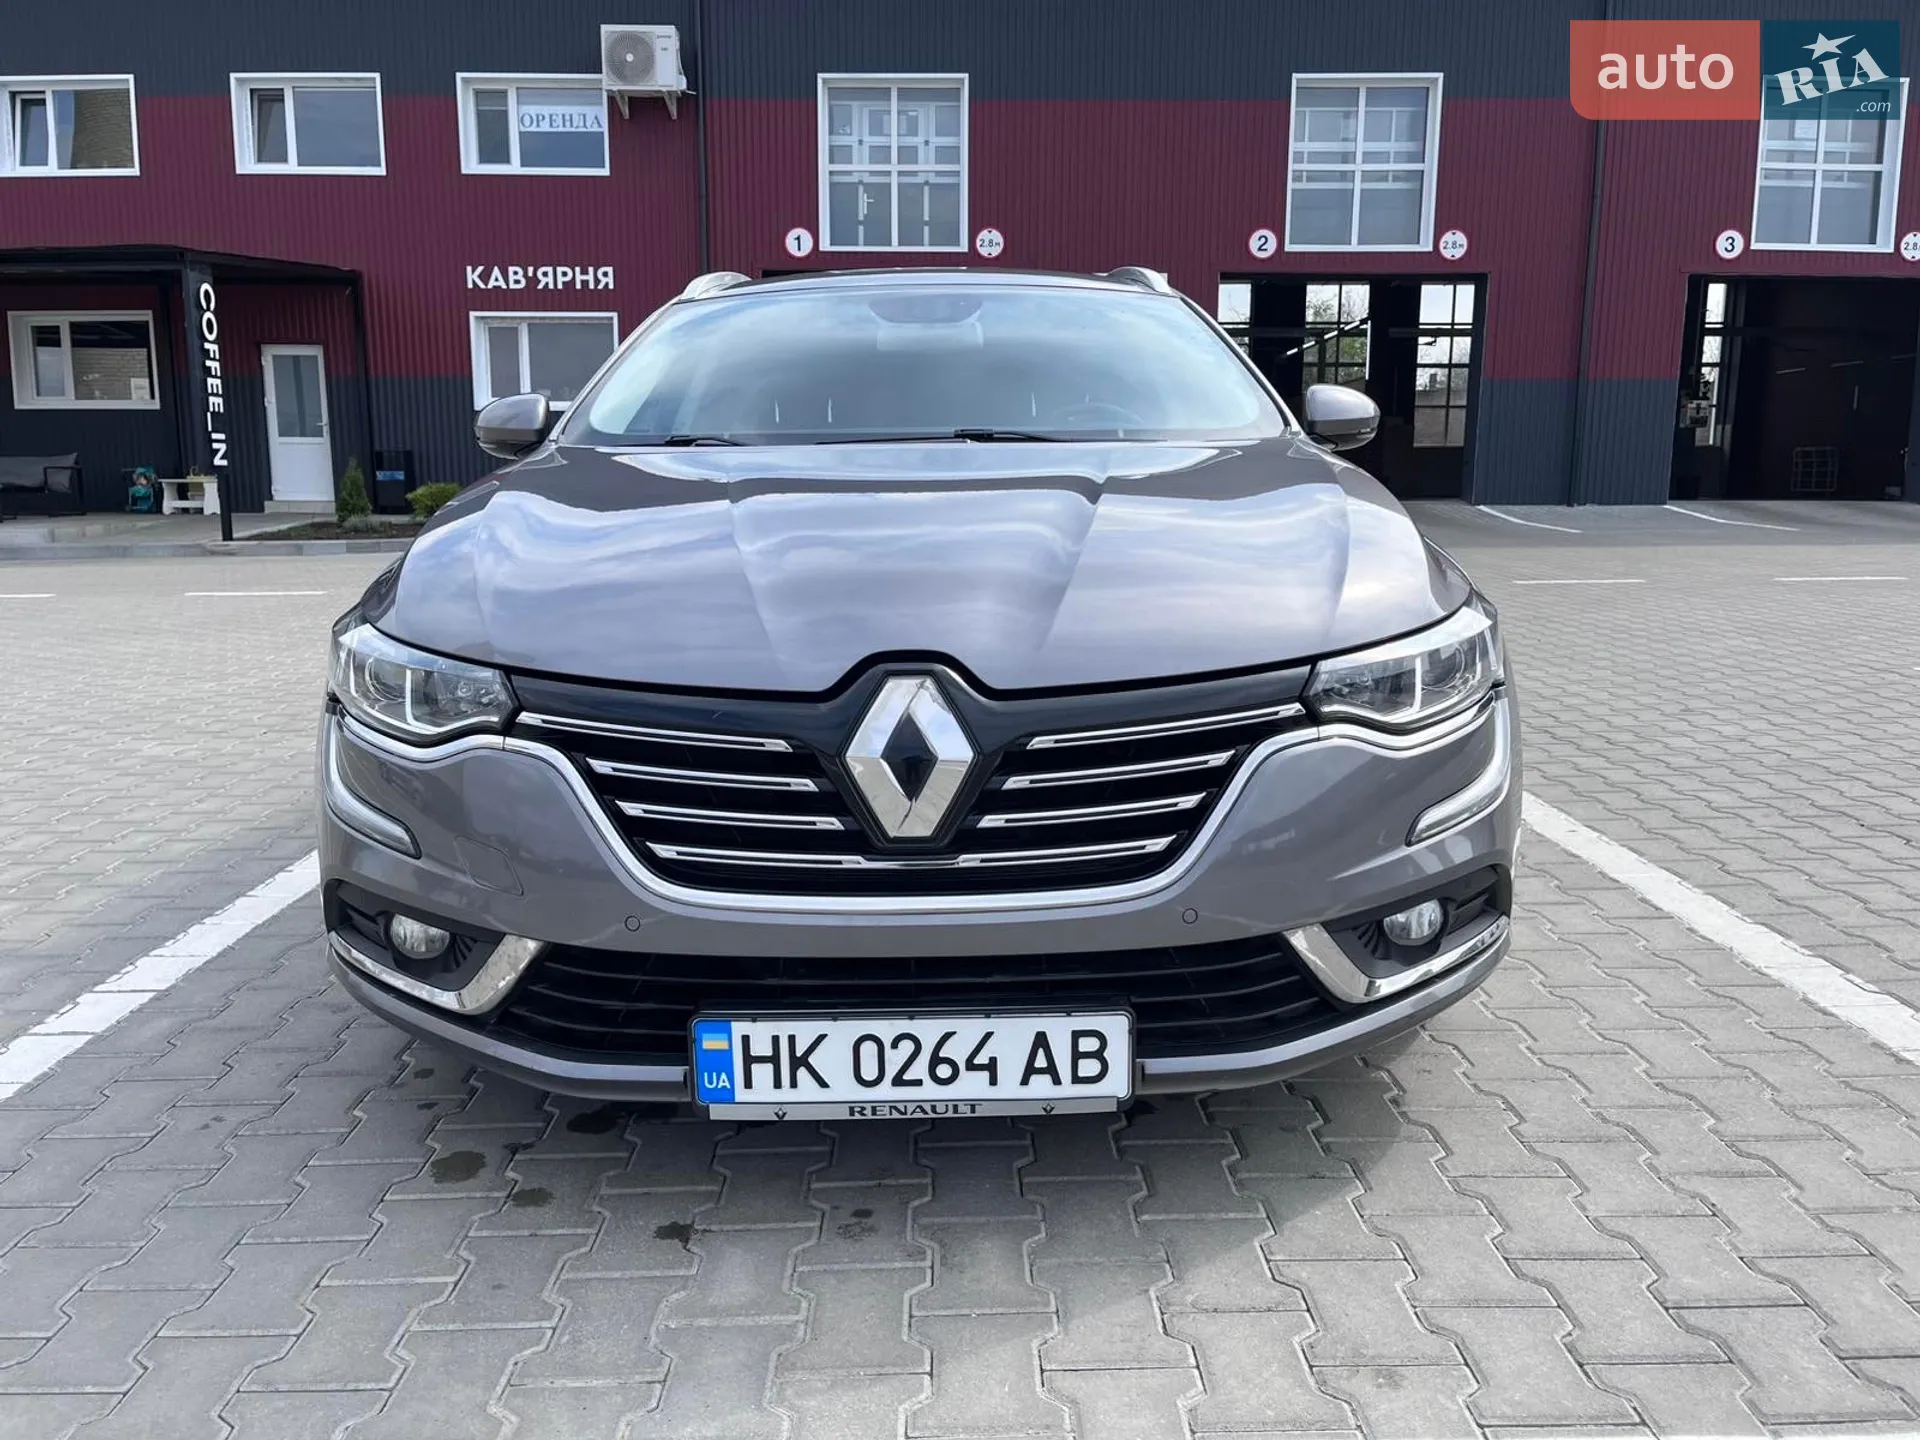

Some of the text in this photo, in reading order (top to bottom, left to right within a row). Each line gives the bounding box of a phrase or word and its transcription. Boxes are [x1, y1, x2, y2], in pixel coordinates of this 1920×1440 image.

[519, 112, 604, 130] ОРЕНДА
[793, 234, 801, 252] 1
[1257, 234, 1269, 251] 2
[1724, 236, 1736, 253] 3
[1903, 241, 1920, 251] 2.8
[465, 265, 615, 290] КАВ'ЯРНЯ
[741, 1029, 1110, 1089] HK 0264 AB
[703, 1071, 731, 1089] UA
[847, 1102, 983, 1117] RENAULT
